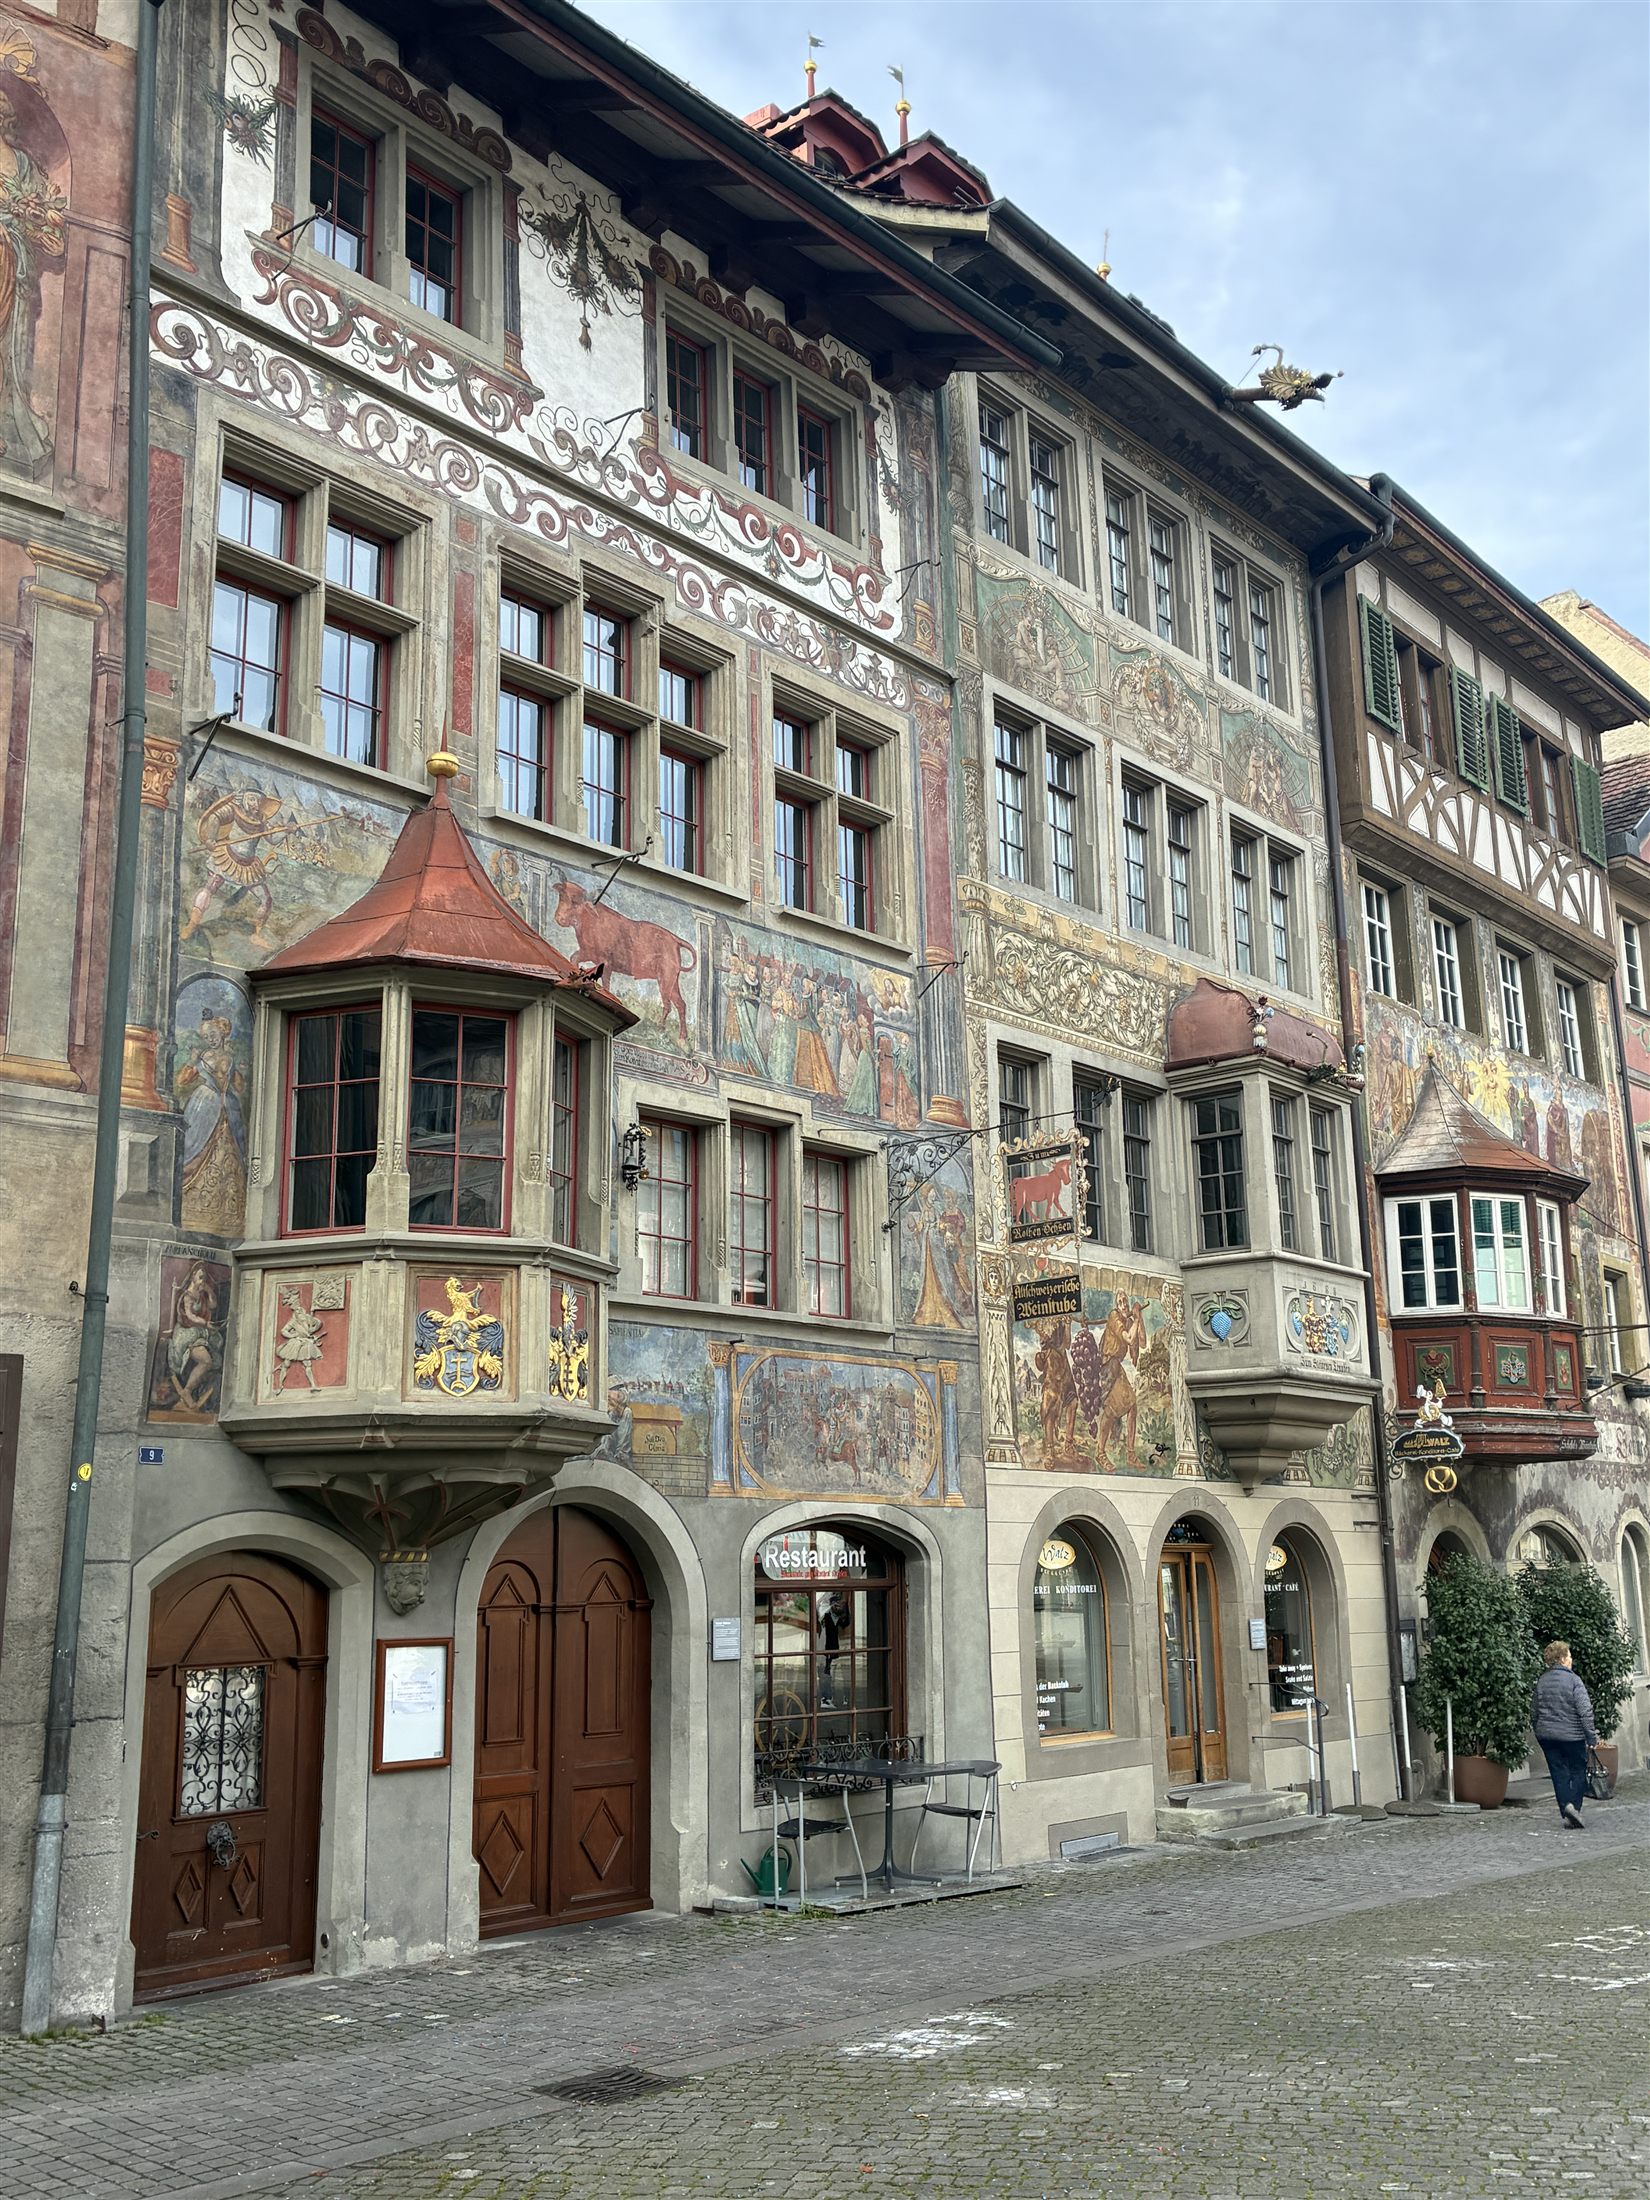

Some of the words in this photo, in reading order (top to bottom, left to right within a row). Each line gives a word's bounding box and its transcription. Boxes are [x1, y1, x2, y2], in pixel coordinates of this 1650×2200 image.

[1017, 1294, 1077, 1319] Weinstube
[150, 1450, 154, 1460] 9
[765, 1545, 866, 1568] Restaurant
[1043, 1544, 1069, 1561] Walz
[1056, 1585, 1097, 1594] KONDITOREI
